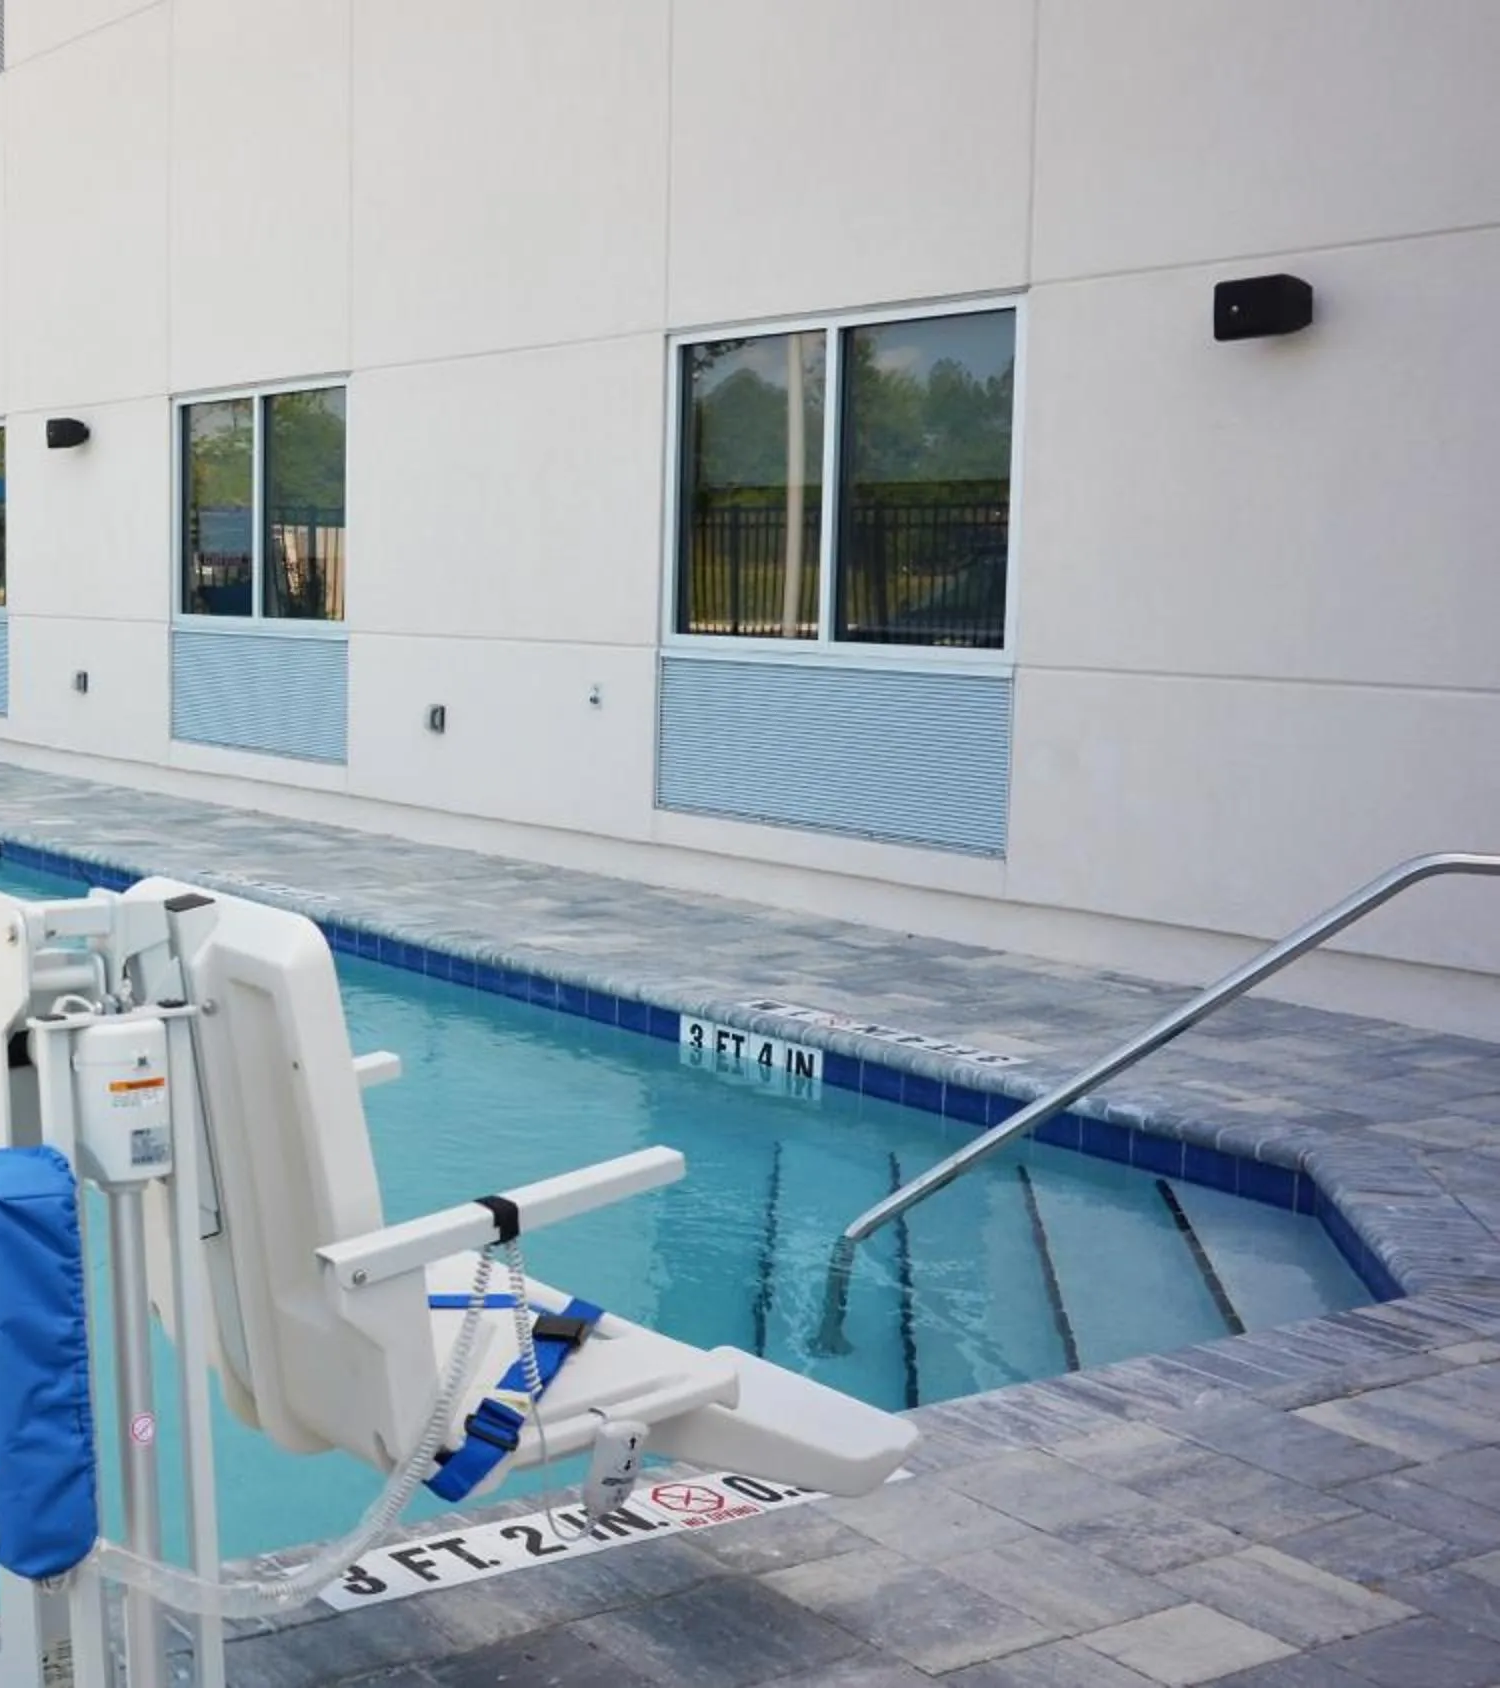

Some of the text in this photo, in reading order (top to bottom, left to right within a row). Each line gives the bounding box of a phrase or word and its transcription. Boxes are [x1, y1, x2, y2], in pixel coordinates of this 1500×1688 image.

[690, 1023, 703, 1048] 3
[717, 1030, 745, 1058] FT
[758, 1042, 773, 1067] 4
[786, 1048, 814, 1078] IN
[342, 1507, 669, 1595] 3 FT. 2 IN.
